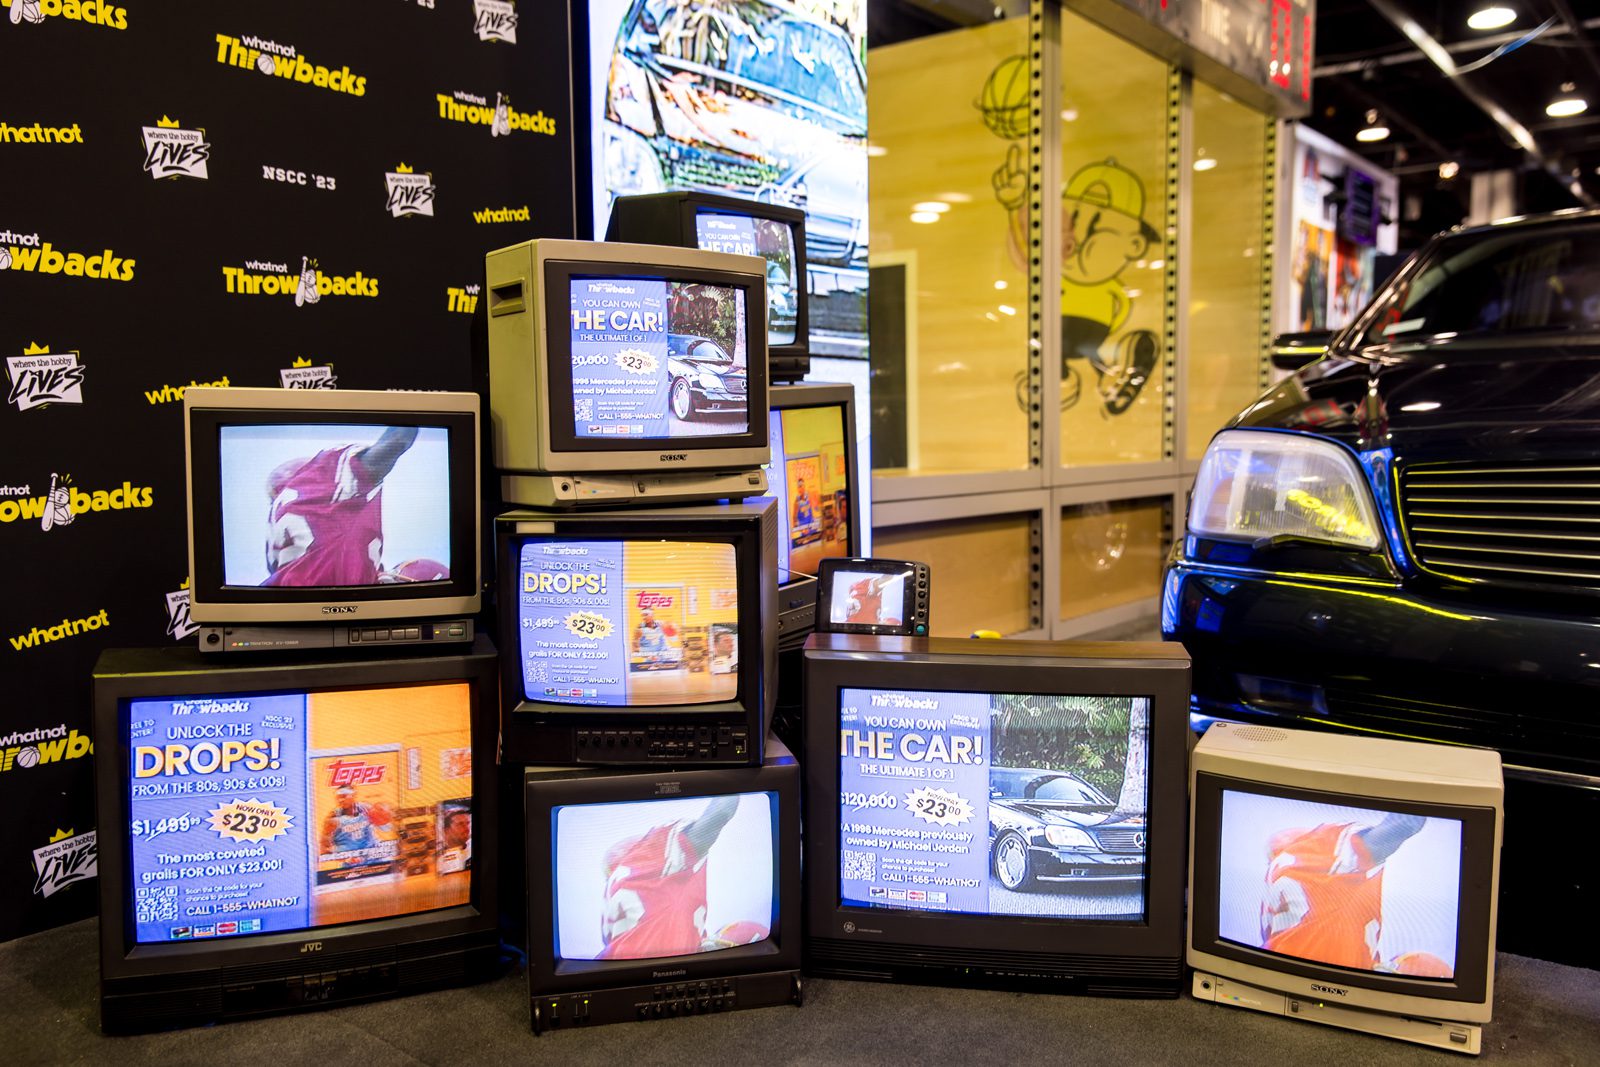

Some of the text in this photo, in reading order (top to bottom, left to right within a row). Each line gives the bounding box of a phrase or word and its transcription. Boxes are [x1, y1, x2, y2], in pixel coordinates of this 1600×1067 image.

[0, 0, 128, 30] backs
[475, 10, 517, 32] LIVES
[242, 35, 296, 58] whatnot
[216, 34, 366, 96] Throwbacks
[454, 90, 486, 105] whatnot
[437, 93, 556, 136] Throwbacks
[148, 131, 168, 139] where
[180, 134, 198, 142] hobby
[144, 140, 209, 170] LIVES
[263, 166, 336, 190] NSCC '23
[387, 184, 435, 210] LIVES
[473, 205, 530, 224] whatnot
[246, 260, 287, 273] whatnot
[222, 266, 378, 297] Throwbacks
[601, 300, 620, 308] CAN
[620, 301, 641, 309] OWN
[610, 310, 664, 333] CAR!
[595, 334, 628, 342] ULTIMATE
[13, 358, 72, 368] where the hobby
[9, 366, 85, 403] LIVES
[660, 454, 687, 462] SONY
[540, 562, 573, 571] UNLOCK
[573, 562, 591, 571] THE
[523, 572, 607, 595] DROPS!
[322, 606, 358, 614] SONY
[522, 596, 543, 604] FROM
[9, 609, 110, 651] whatnot
[562, 651, 581, 659] ONLY
[167, 723, 252, 739] UNLOCK THE
[864, 716, 887, 728] YOU
[889, 717, 914, 730] CAN
[916, 719, 946, 731] OWN
[0, 723, 67, 747] whatnot
[135, 737, 281, 778] DROPS!
[841, 730, 984, 765] THE CAR!
[327, 759, 387, 788] Topps
[860, 763, 954, 779] THE ULTIMATE 1 OF 1
[133, 776, 286, 796] FROM THE 80s, 90s & 00s!
[236, 804, 275, 816] NOW ONLY
[843, 823, 851, 832] A
[872, 825, 920, 839] Mercedes
[921, 829, 974, 843] previously
[38, 833, 96, 859] where the hobby
[157, 846, 265, 864] The most coveted
[846, 838, 969, 854] owned by Michael Jordan
[180, 866, 205, 879] FOR
[206, 865, 237, 877] ONLY
[239, 859, 283, 874] $23.00!
[881, 873, 981, 888] CALL 1-555-WHATNOT
[186, 896, 299, 917] CALL 1-555-WHATNOT
[302, 942, 322, 952] JVC
[1310, 984, 1348, 996] SONY
